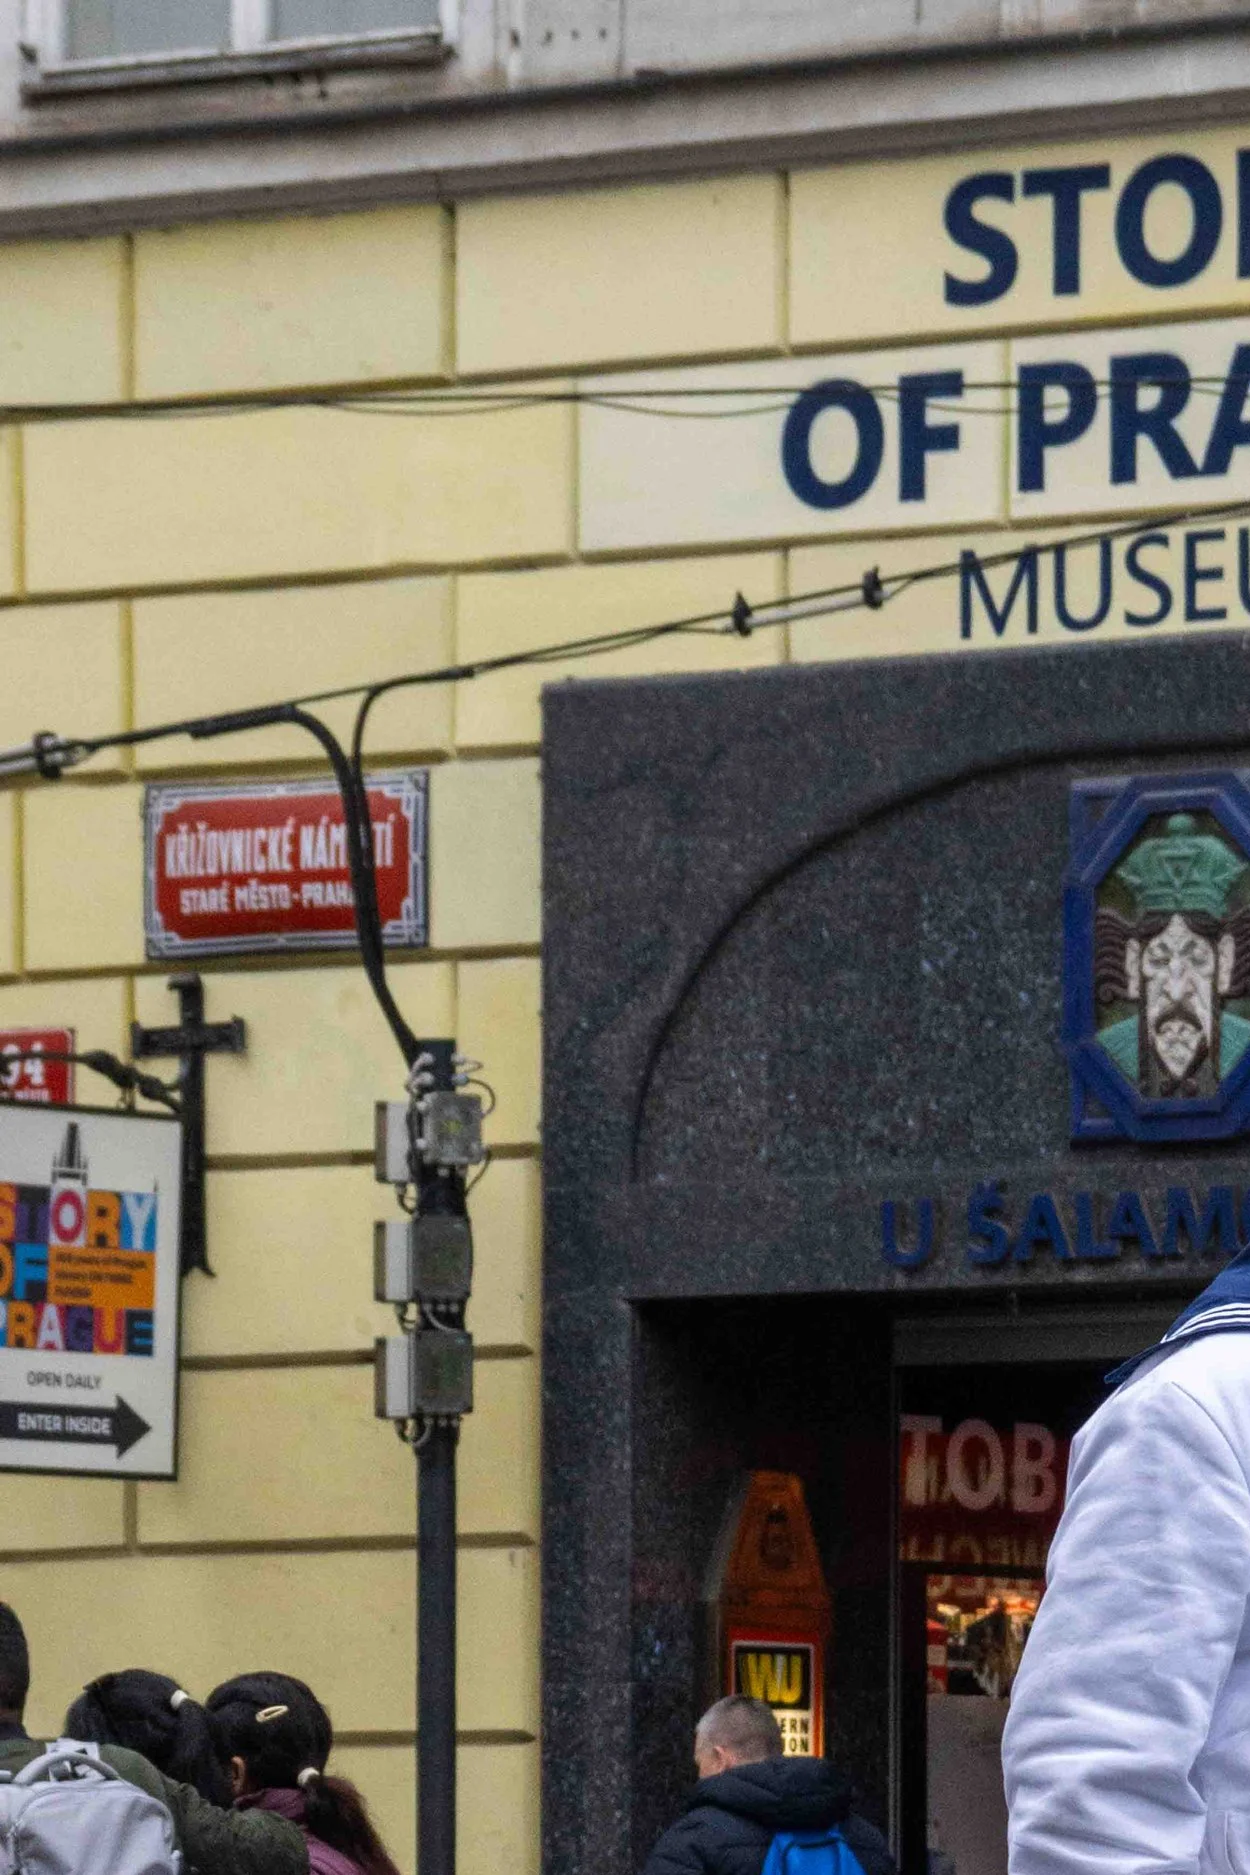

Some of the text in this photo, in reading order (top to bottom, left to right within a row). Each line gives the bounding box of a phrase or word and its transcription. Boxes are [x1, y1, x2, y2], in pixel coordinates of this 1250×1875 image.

[781, 369, 966, 510] OF
[165, 813, 396, 878] KŘIŽOVNICKÉ NÁMTÍ
[180, 881, 230, 916] STARÉ
[881, 1197, 933, 1267] U
[0, 1301, 154, 1356] RAGUE
[27, 1371, 101, 1389] OPEN DAILY
[17, 1413, 111, 1435] ENTER INSIDE
